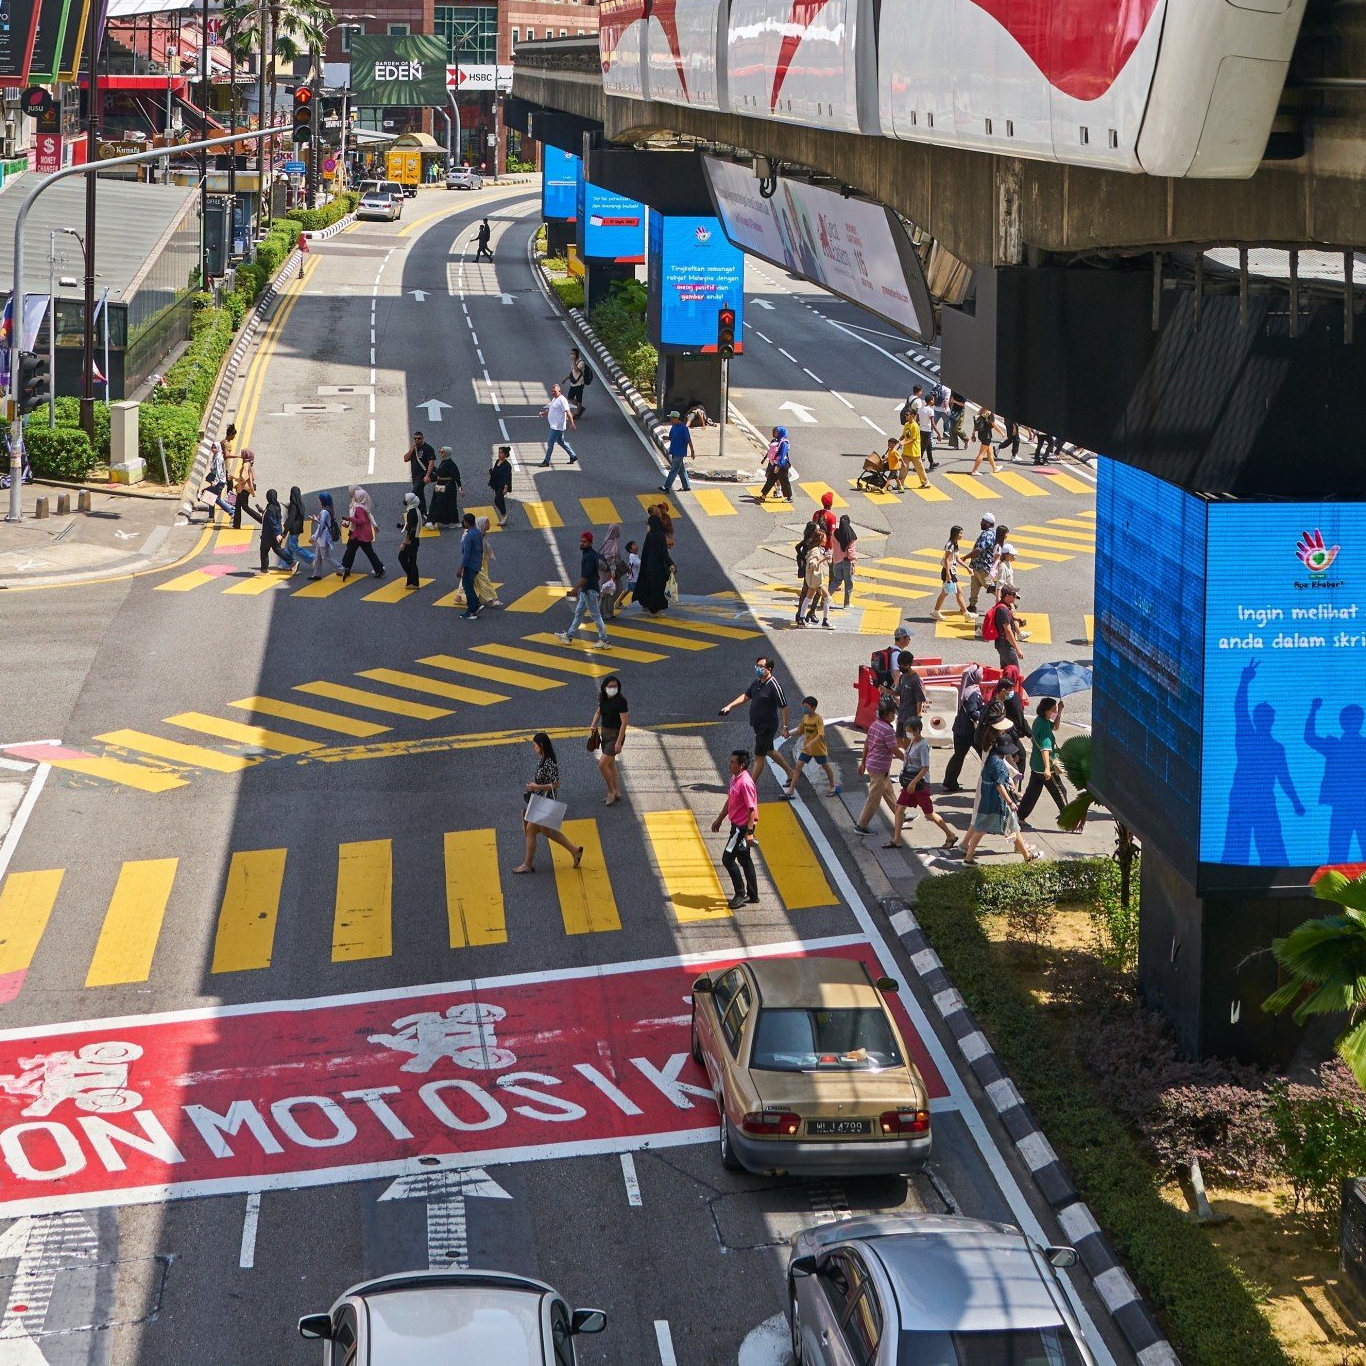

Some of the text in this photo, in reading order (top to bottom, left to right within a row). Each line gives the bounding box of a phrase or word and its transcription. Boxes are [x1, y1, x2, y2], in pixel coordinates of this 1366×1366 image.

[375, 65, 422, 81] EDEN
[469, 72, 493, 82] HSBC
[40, 156, 57, 165] MONEY
[1293, 581, 1309, 590] Apa
[1237, 604, 1284, 628] Ingin
[1291, 603, 1359, 620] melihat
[1218, 635, 1264, 650] anda
[1272, 632, 1326, 649] dalam
